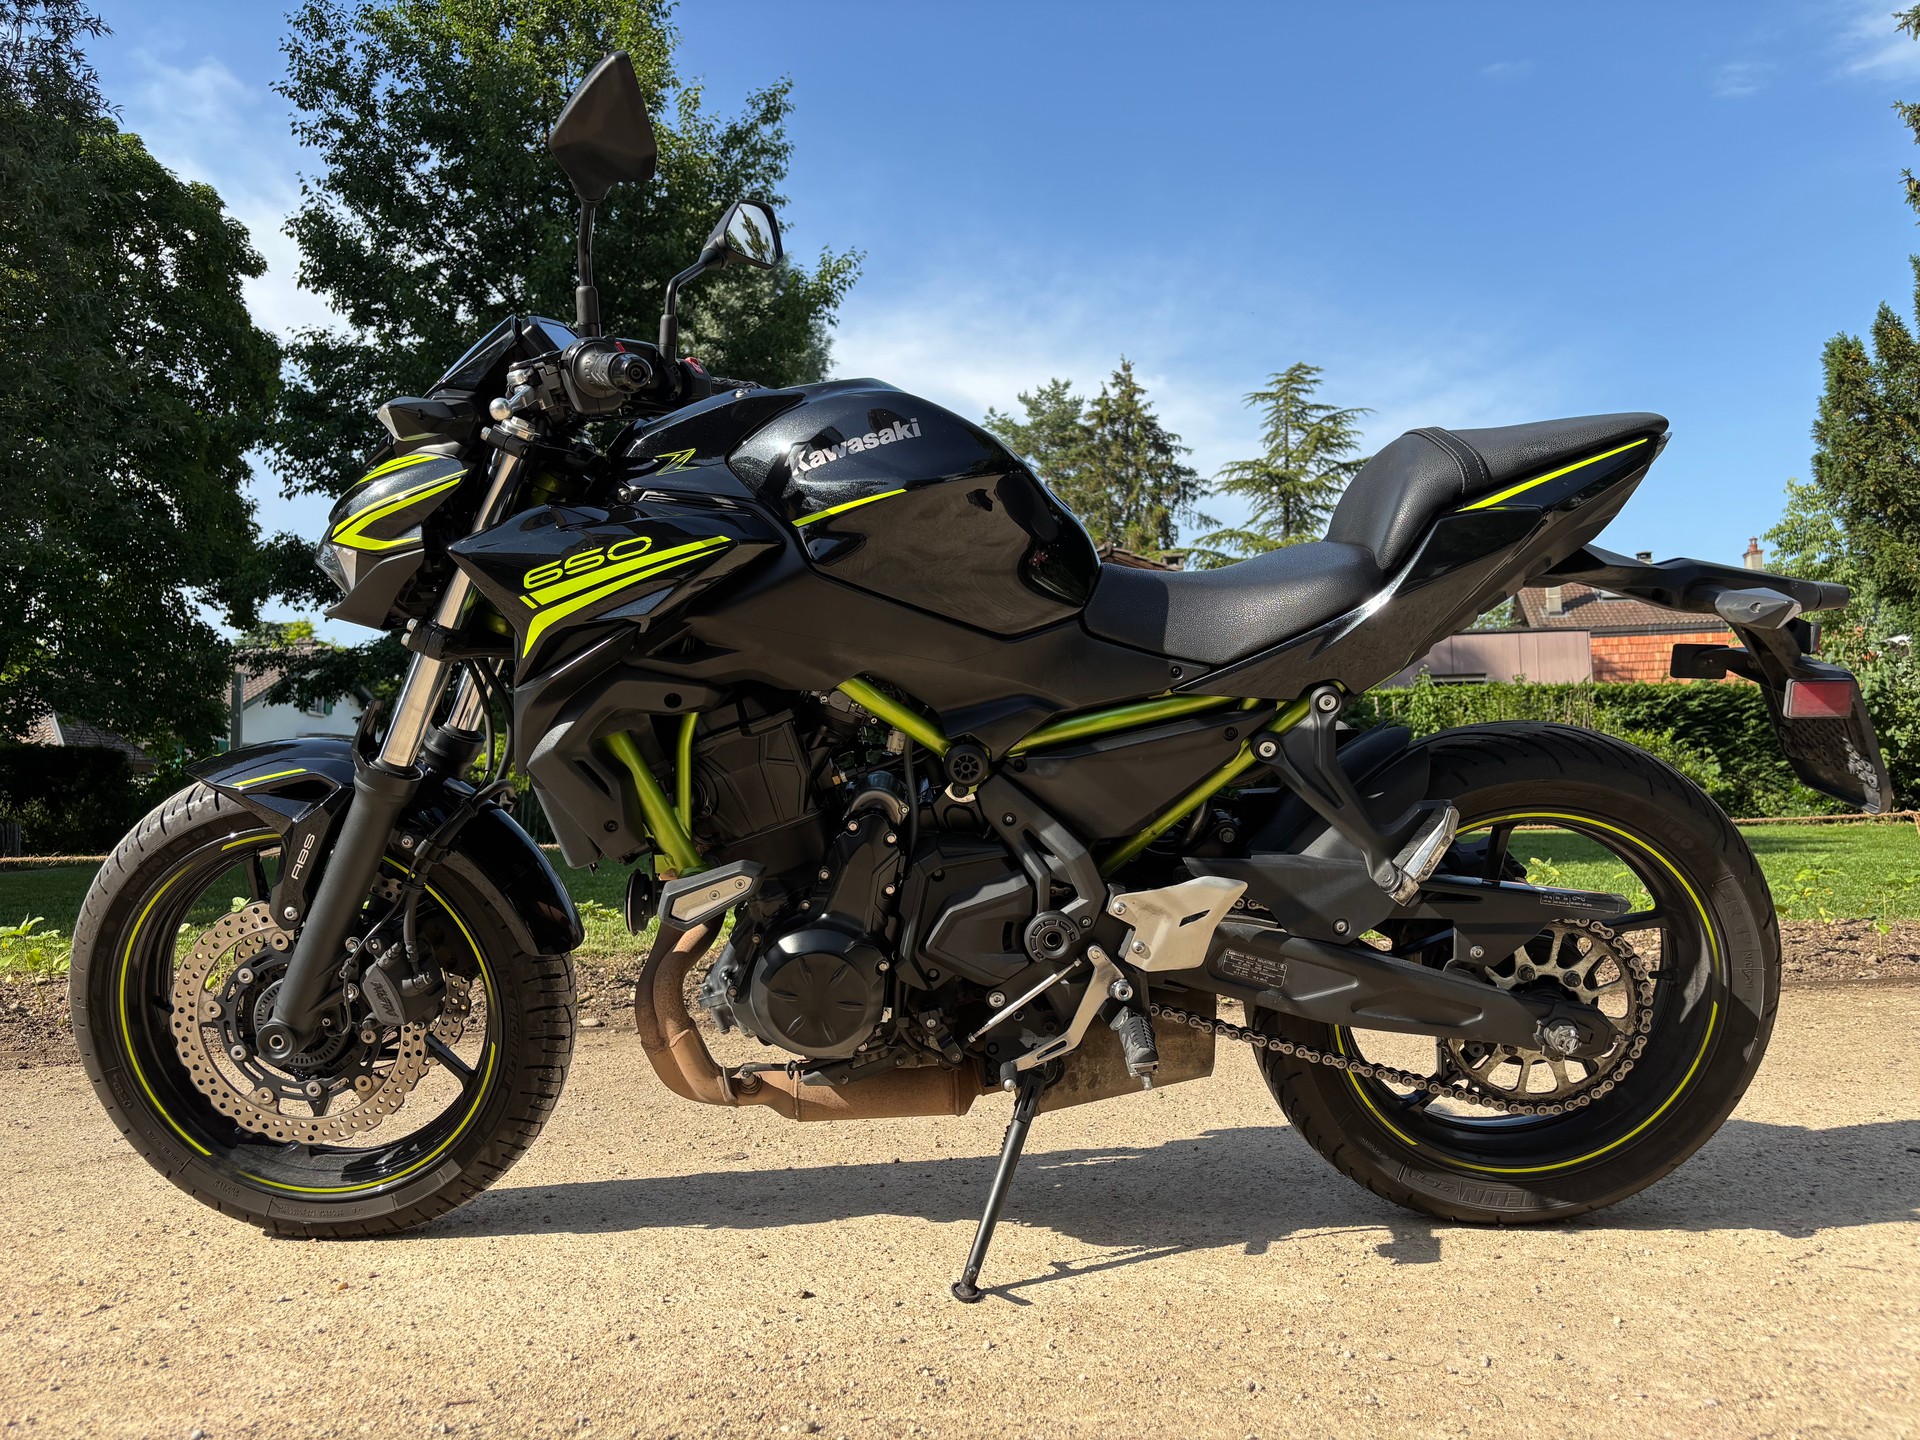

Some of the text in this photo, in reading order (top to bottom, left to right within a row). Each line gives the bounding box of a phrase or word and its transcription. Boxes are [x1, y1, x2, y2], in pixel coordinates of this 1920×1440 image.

[790, 418, 922, 476] Kawasaki
[523, 536, 652, 589] 650
[291, 833, 315, 880] ABS
